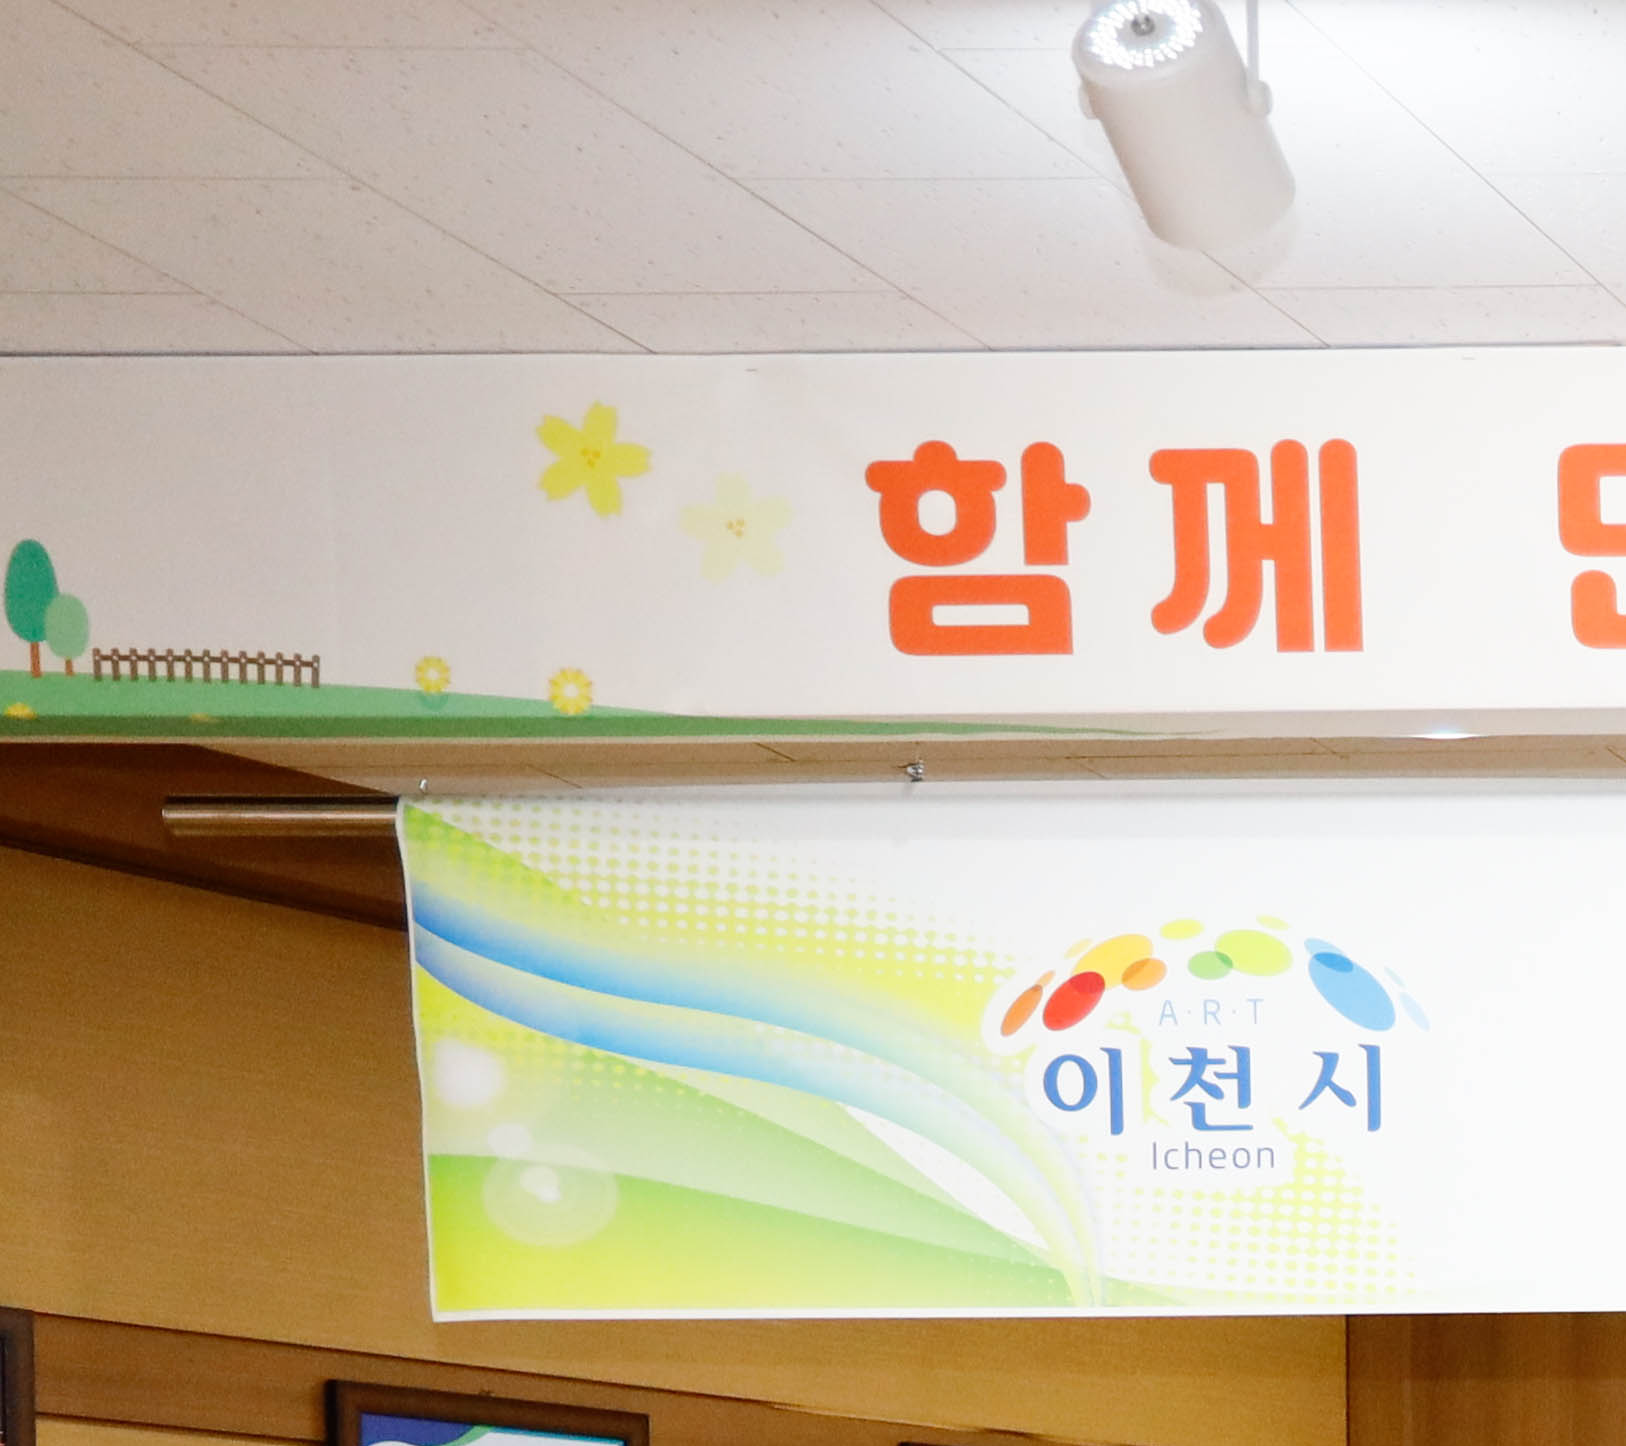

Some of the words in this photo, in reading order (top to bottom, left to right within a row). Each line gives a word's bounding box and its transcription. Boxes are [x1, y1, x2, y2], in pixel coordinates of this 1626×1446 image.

[865, 438, 1363, 656] 함께
[1043, 1044, 1382, 1135] 이천시
[1152, 1141, 1276, 1171] Icheon
